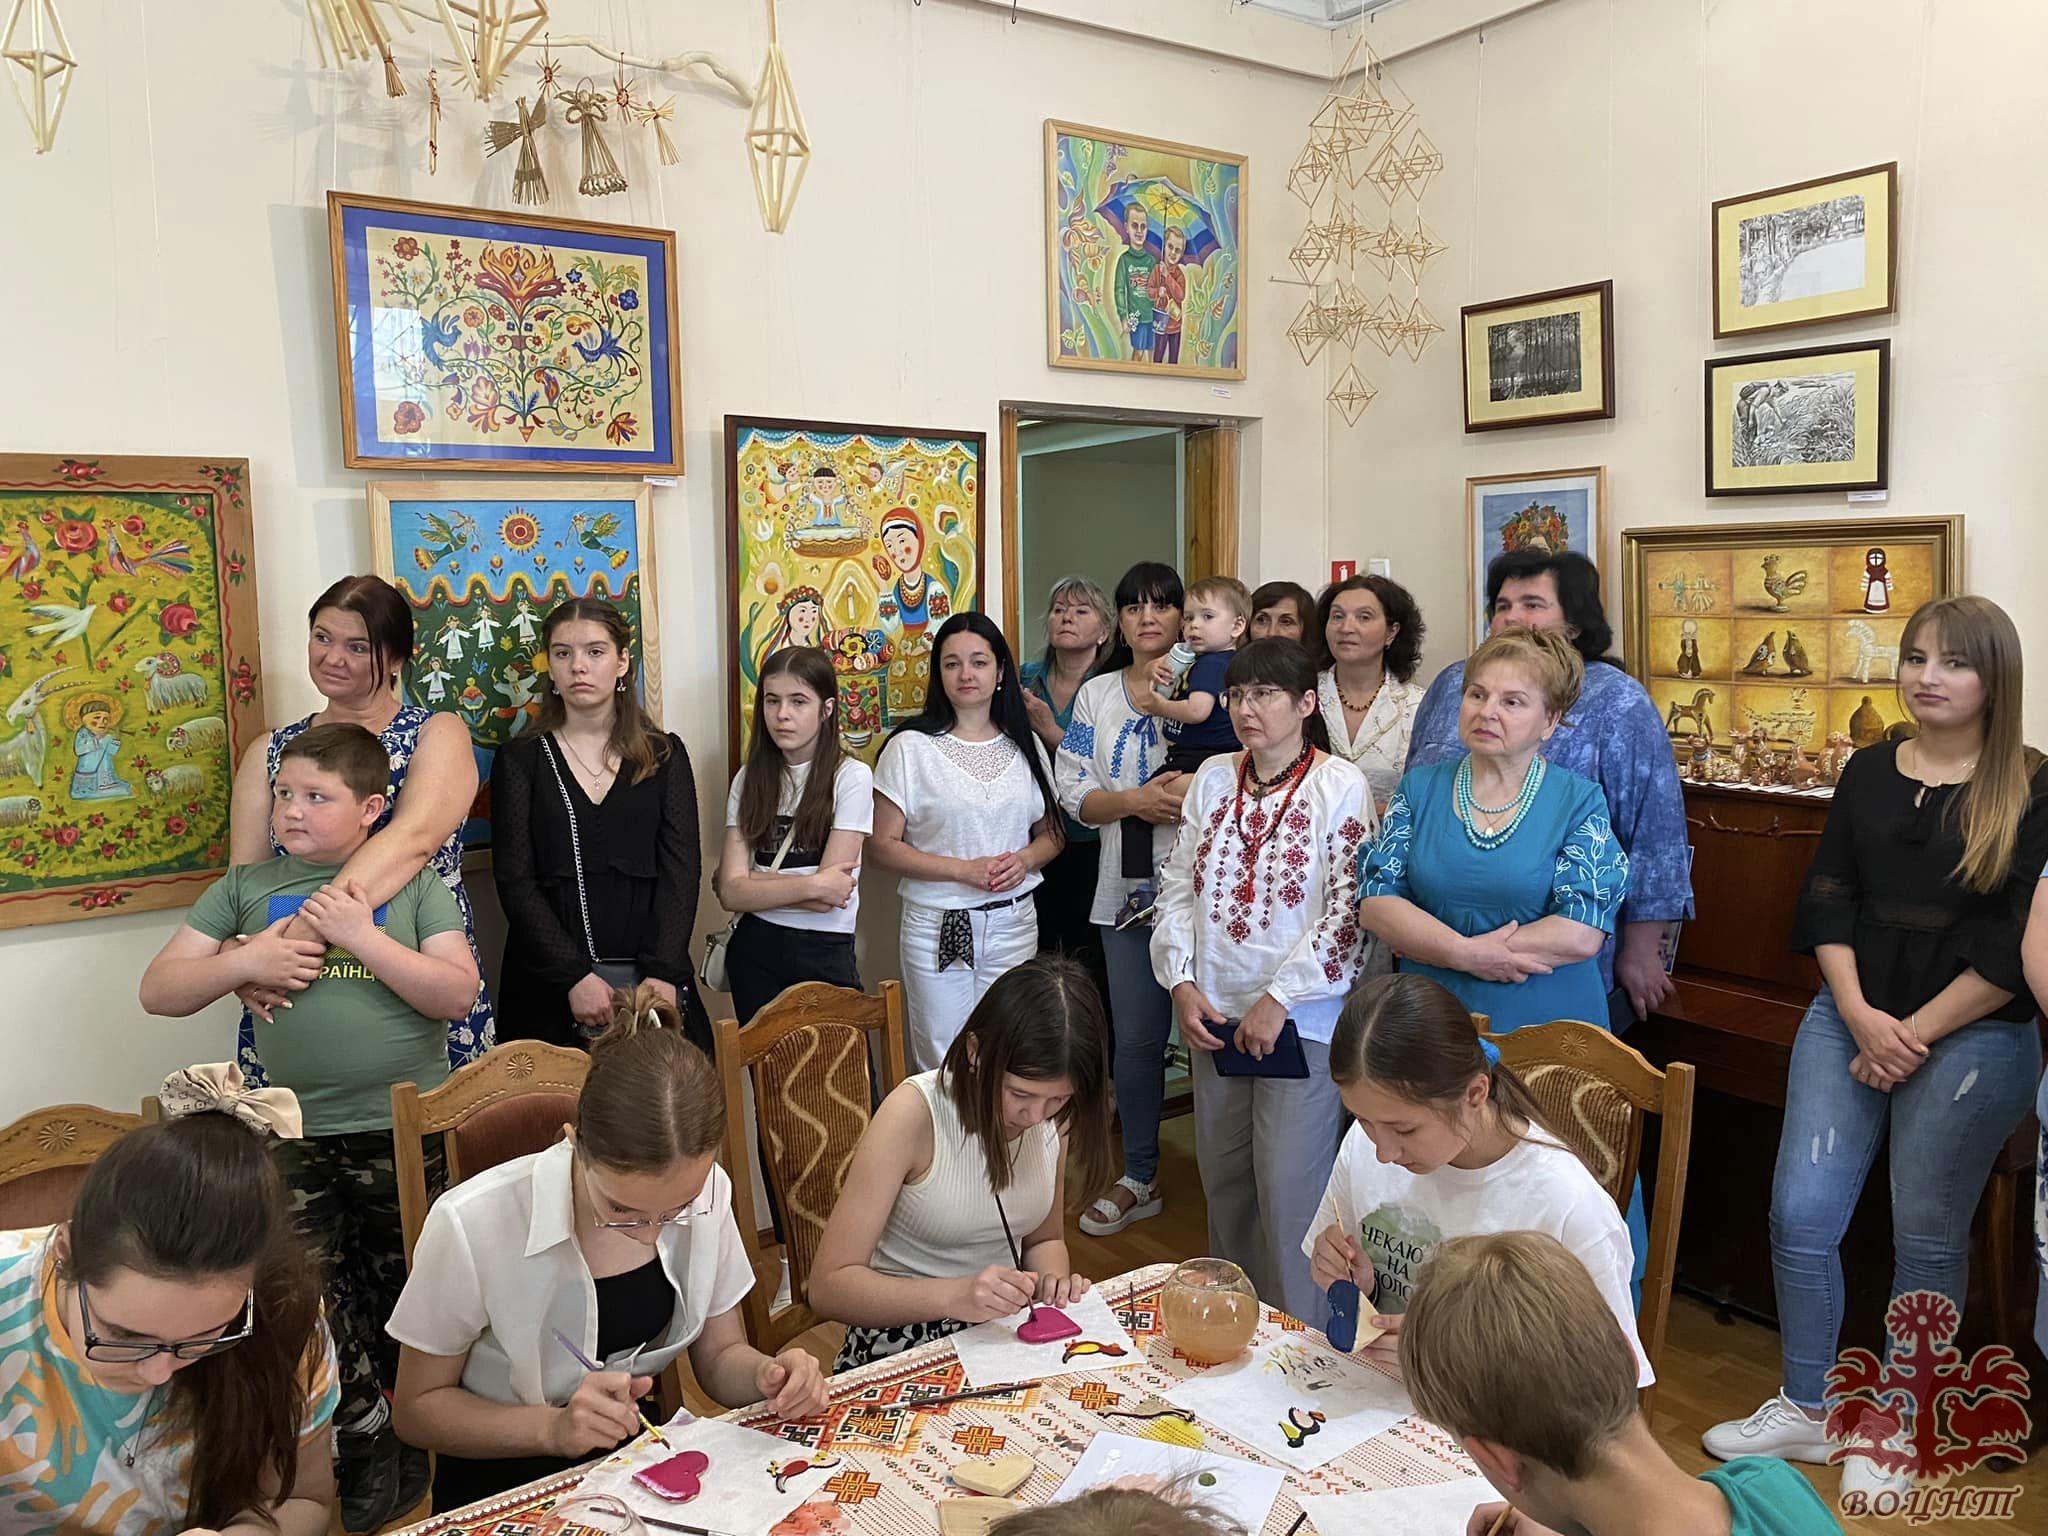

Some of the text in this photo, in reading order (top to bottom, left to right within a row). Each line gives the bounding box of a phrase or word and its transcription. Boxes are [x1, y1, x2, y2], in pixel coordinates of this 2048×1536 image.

[318, 961, 376, 982] РАЇНЦ
[1361, 1223, 1424, 1264] ЧЕКАЮ
[1387, 1255, 1410, 1281] НА
